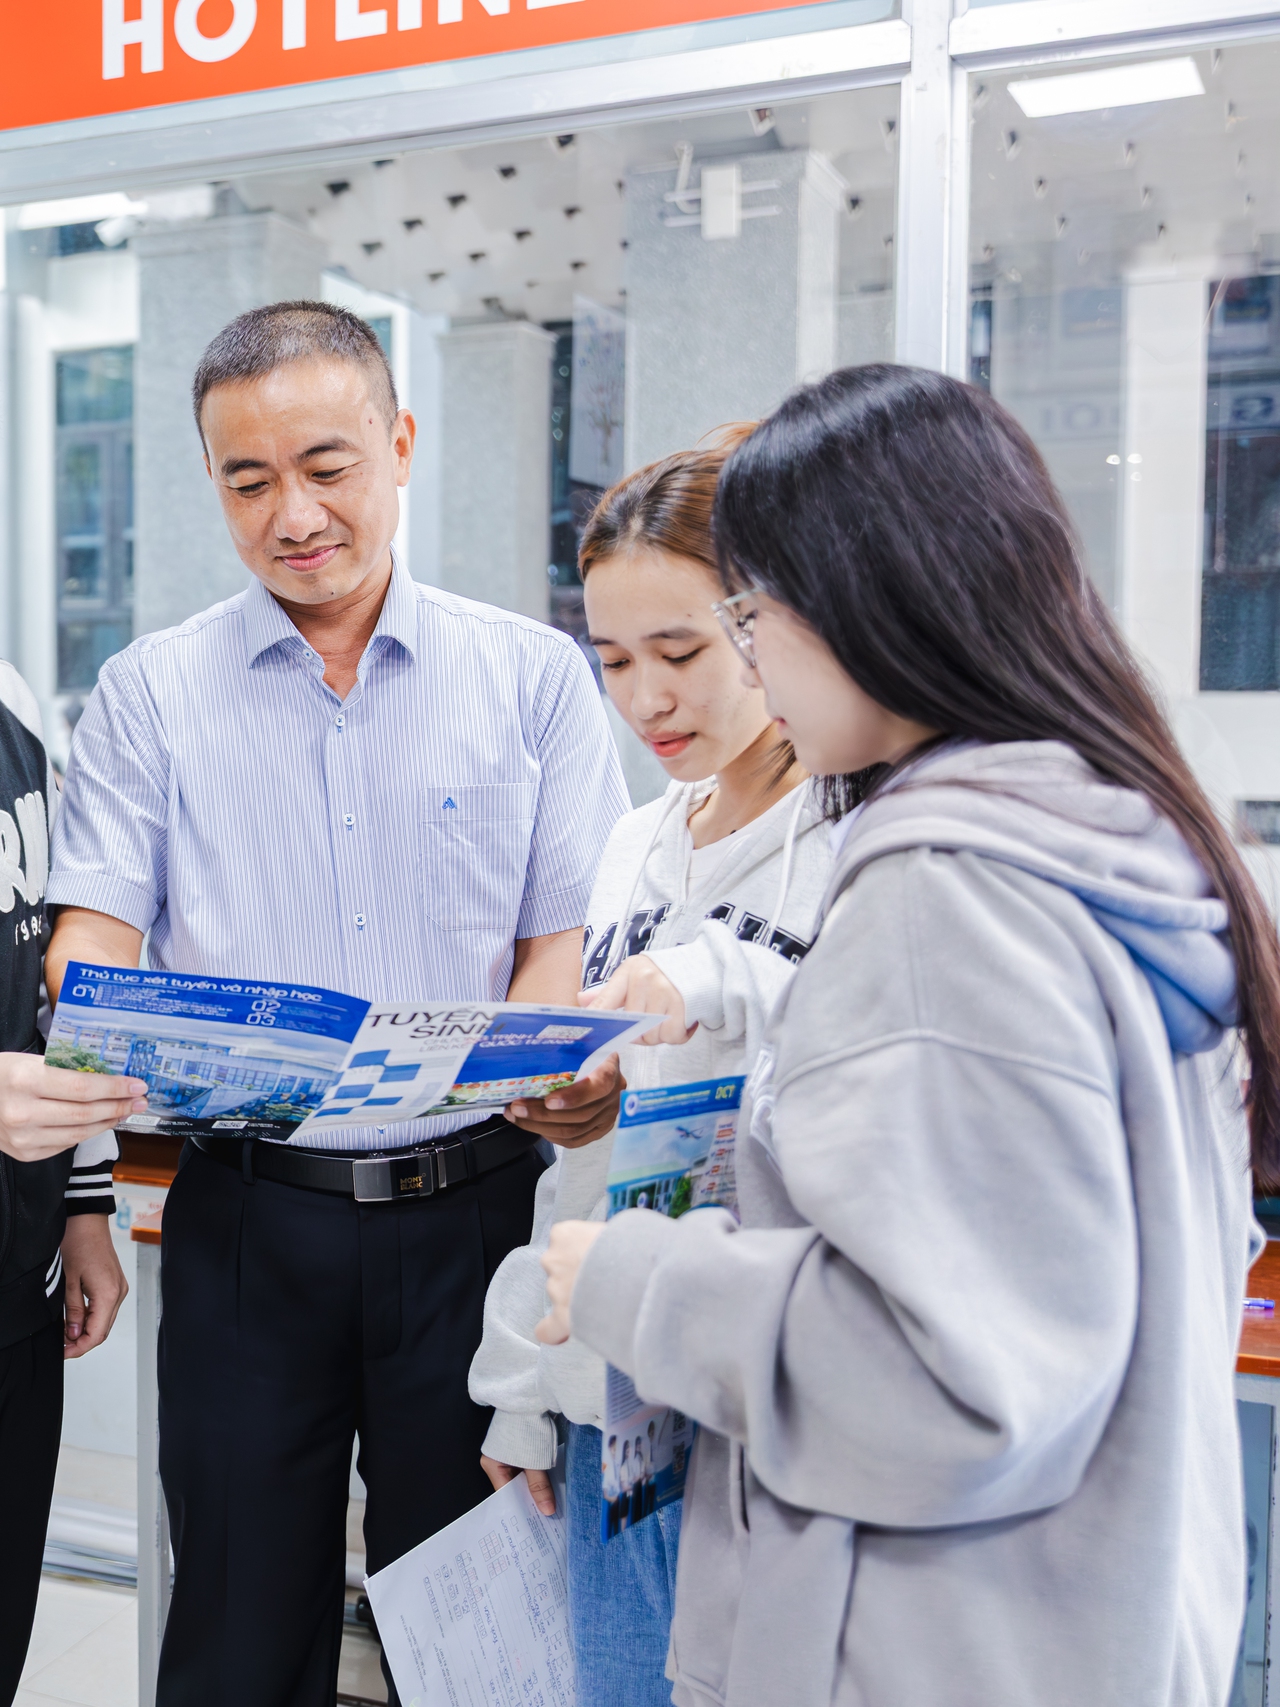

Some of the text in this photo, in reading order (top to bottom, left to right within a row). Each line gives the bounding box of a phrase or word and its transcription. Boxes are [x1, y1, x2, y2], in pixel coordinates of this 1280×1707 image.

[80, 967, 110, 980] Thủ
[113, 973, 140, 983] tục
[221, 983, 243, 993] và
[244, 985, 288, 998] nhập
[290, 989, 323, 1002] học
[72, 985, 96, 999] 01
[251, 999, 281, 1013] 02
[246, 1013, 276, 1026] 03
